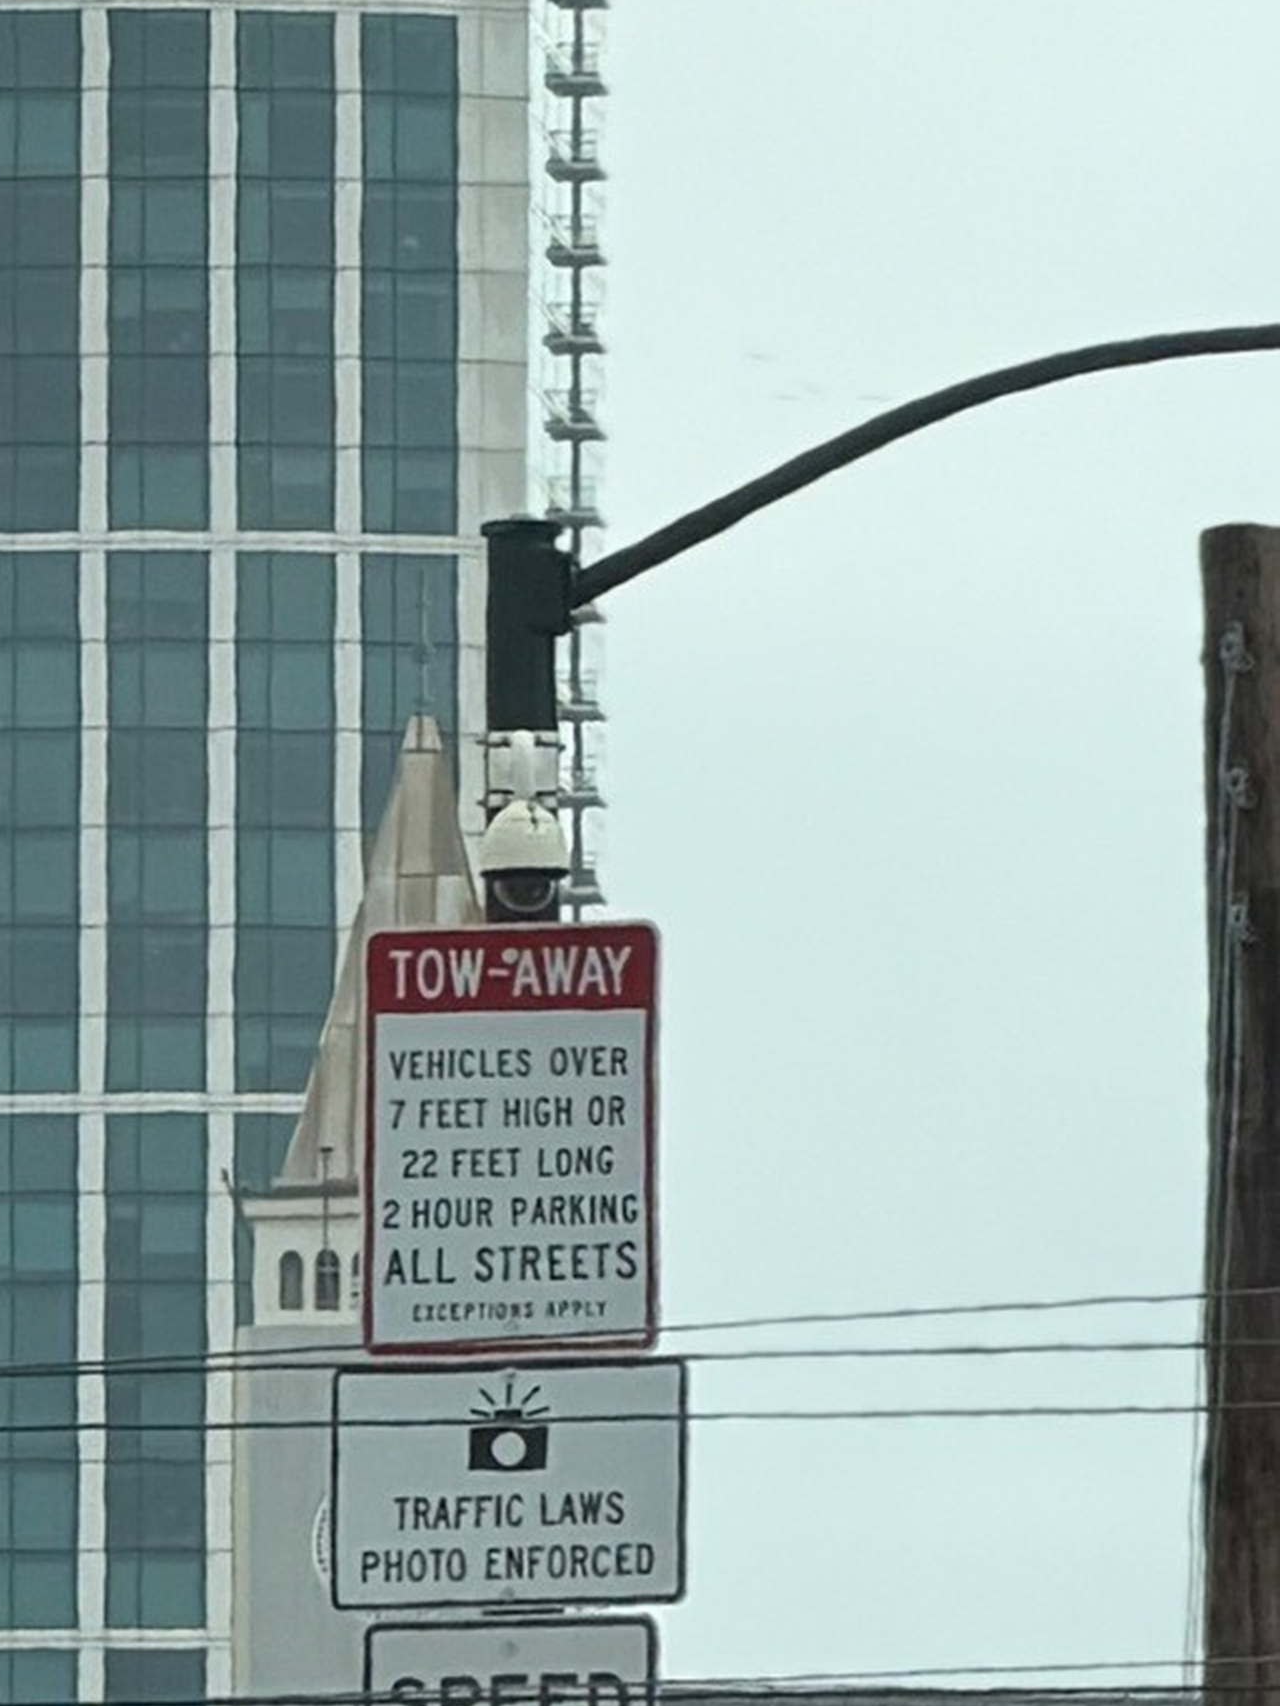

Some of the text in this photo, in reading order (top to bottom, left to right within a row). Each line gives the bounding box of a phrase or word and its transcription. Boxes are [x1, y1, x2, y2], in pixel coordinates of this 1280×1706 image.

[388, 945, 632, 1000] TOW-AWAY
[389, 1046, 628, 1081] VEHICLES OVER
[389, 1095, 626, 1131] 7 FEET HIGH OR
[402, 1144, 614, 1180] 22 FEET LONG
[382, 1193, 639, 1230] 2 HOUR PARKING
[383, 1240, 638, 1286] ALL STREETS
[412, 1299, 607, 1323] EXCEPTIONS APPLY
[393, 1490, 625, 1532] TRAFFIC LAWS
[361, 1542, 655, 1584] PHOTO ENFORCED
